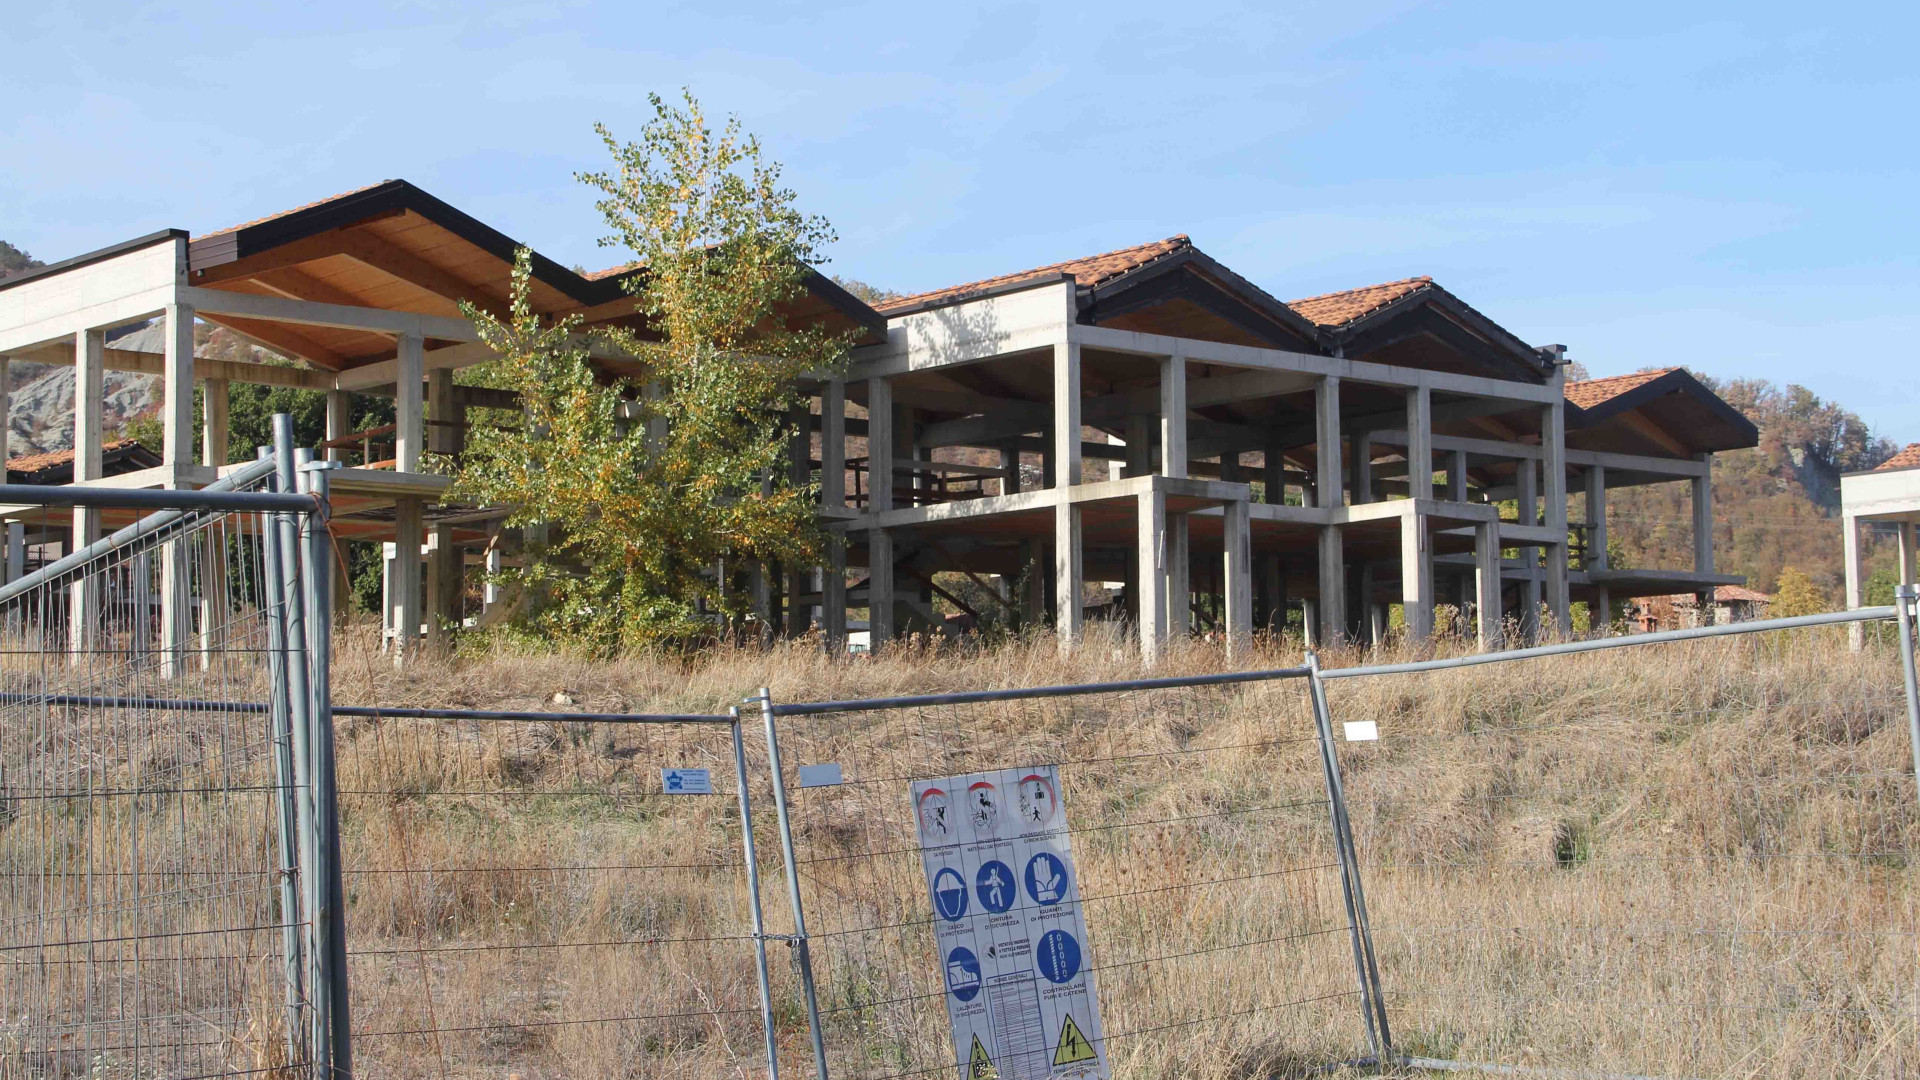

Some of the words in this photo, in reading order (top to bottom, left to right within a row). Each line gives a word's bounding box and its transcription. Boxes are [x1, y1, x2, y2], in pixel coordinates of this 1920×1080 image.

[1040, 906, 1062, 914] GUANTI
[990, 914, 1012, 923] CINTURA
[1038, 910, 1074, 920] PROTEZIONE
[990, 920, 1020, 928] SICUREZZA
[1042, 982, 1086, 994] CONTROLLARE
[1063, 988, 1086, 997] CATENE
